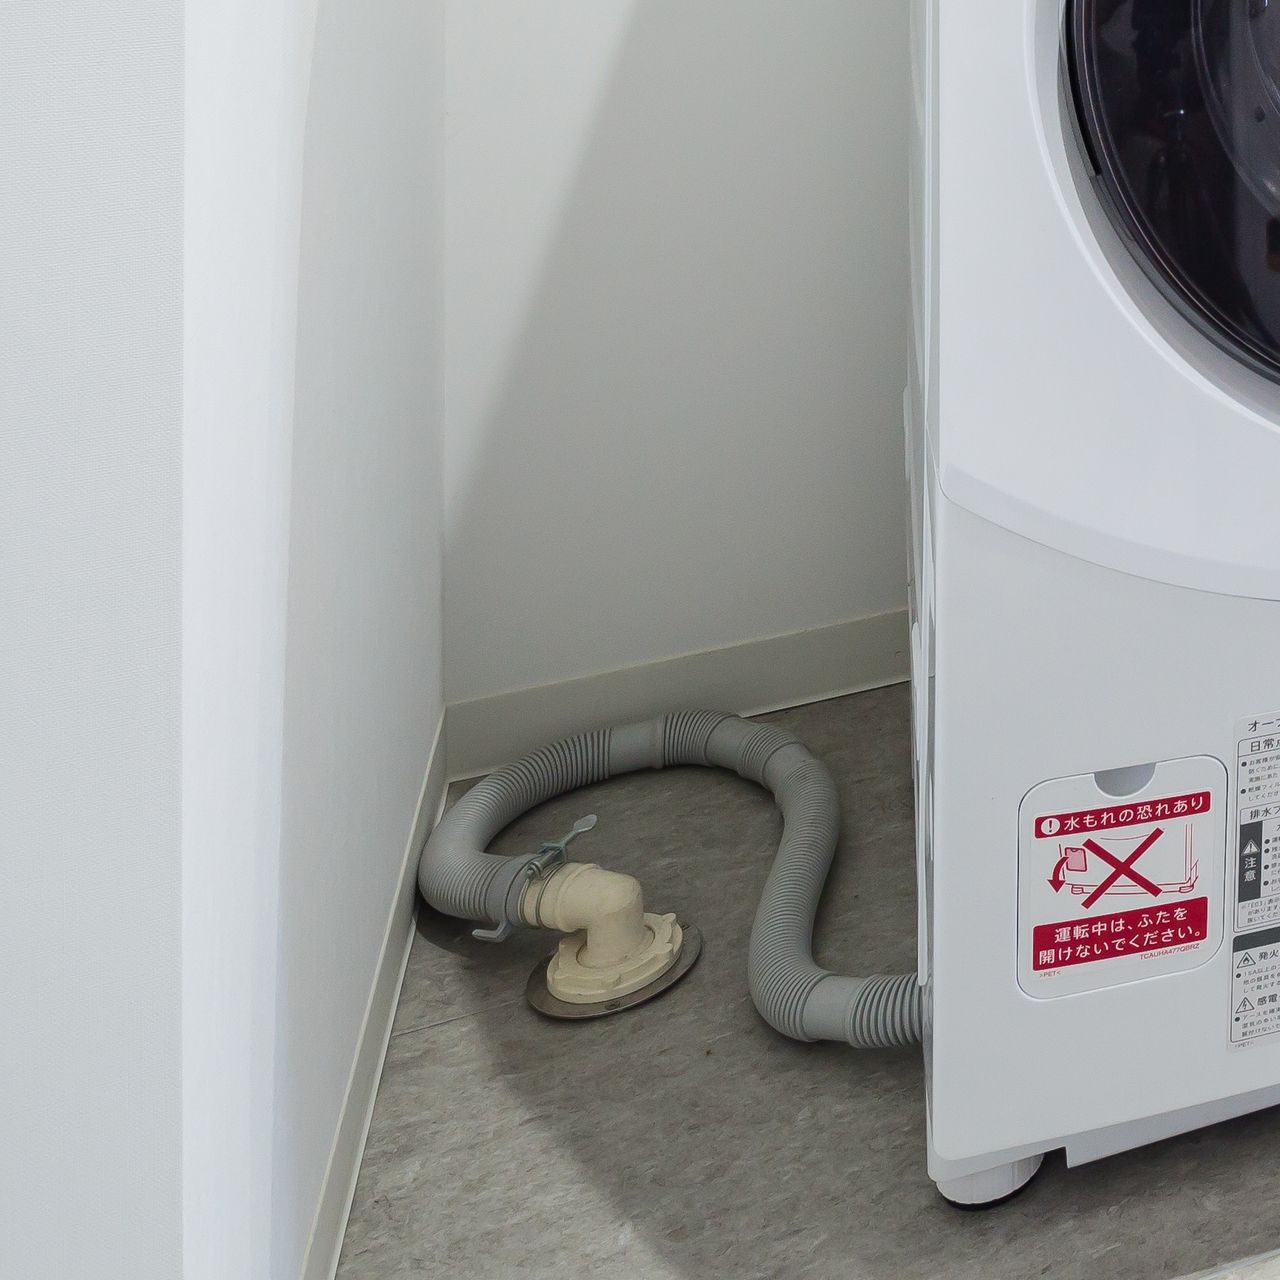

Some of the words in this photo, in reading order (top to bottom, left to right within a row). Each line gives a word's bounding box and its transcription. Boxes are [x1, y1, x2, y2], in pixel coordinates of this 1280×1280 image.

[1065, 796, 1203, 831] 水もれの恐れあり
[1244, 858, 1257, 881] 注意
[1055, 907, 1187, 943] 運転中は、ふたを
[1039, 925, 1200, 965] 開けないでください。
